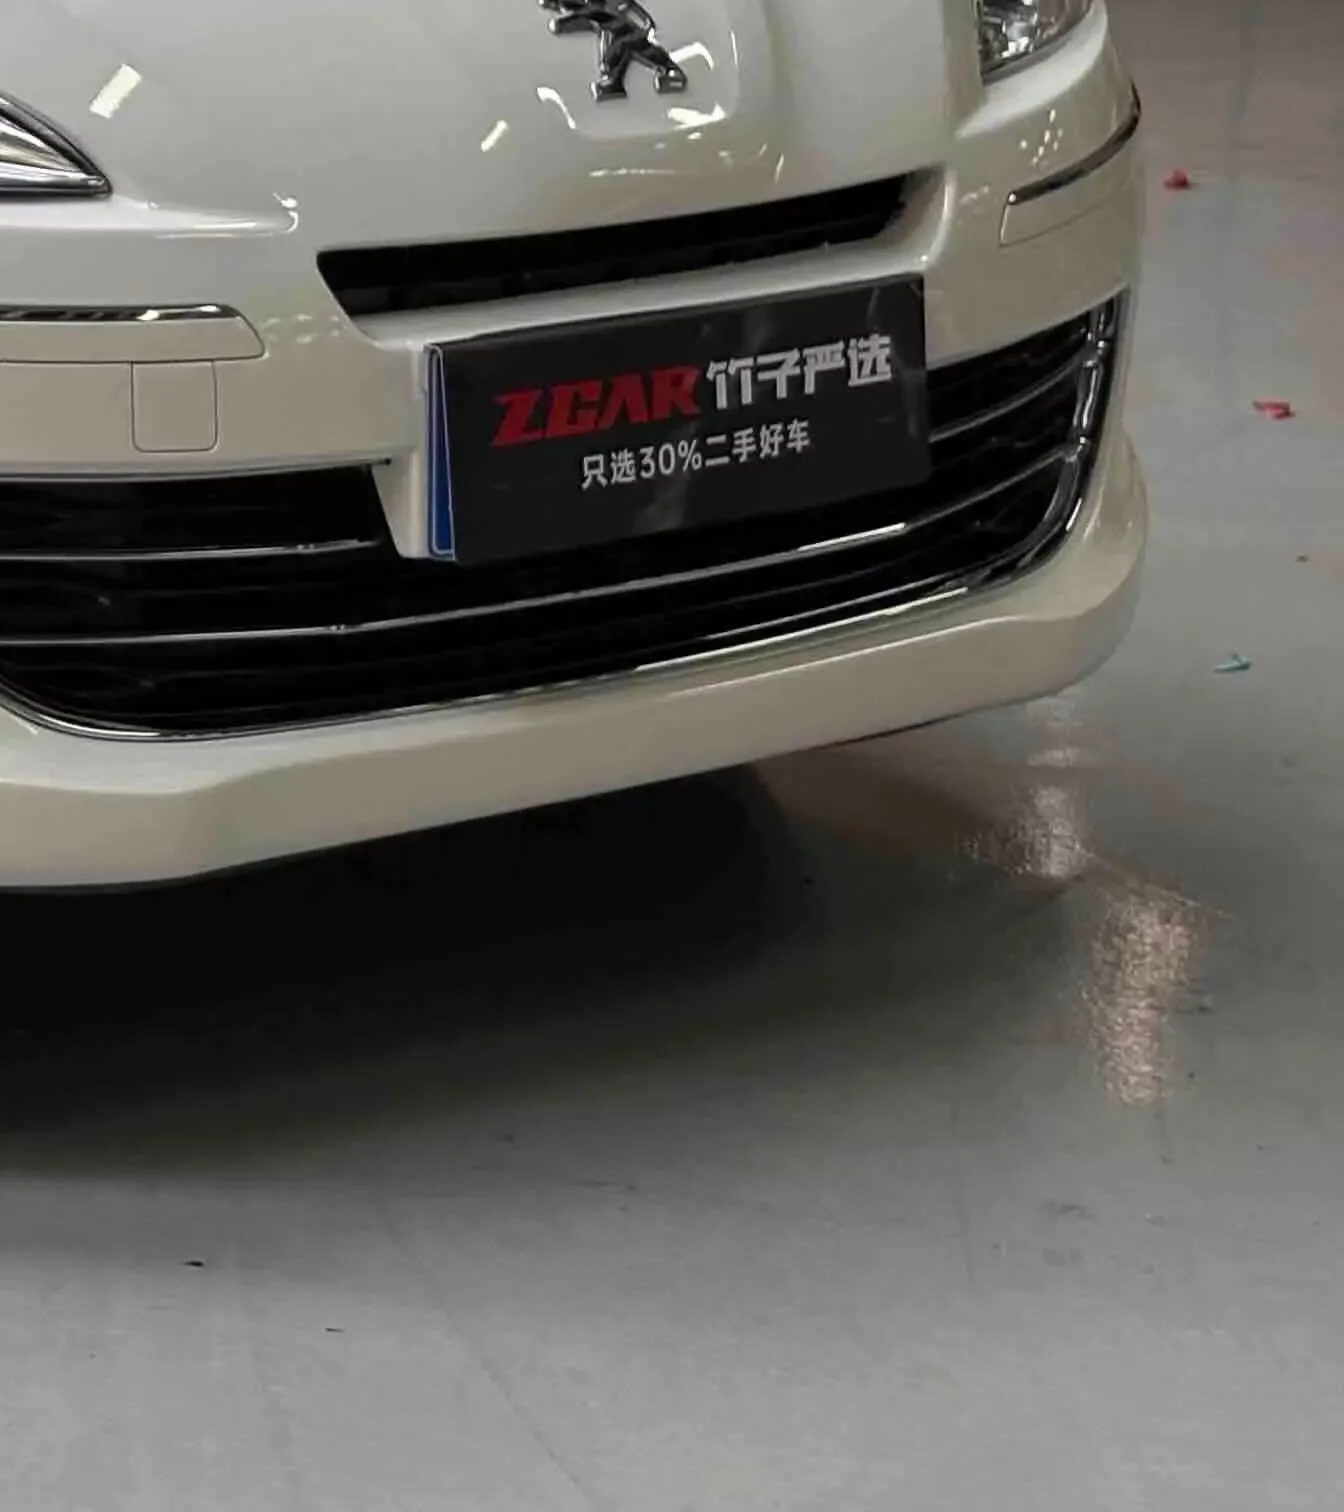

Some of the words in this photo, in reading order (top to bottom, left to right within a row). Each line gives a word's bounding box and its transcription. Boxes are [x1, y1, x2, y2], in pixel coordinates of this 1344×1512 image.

[490, 364, 704, 448] ZCAR
[705, 332, 893, 410] 竹子严选
[580, 418, 812, 491] 只选30%二手好车
